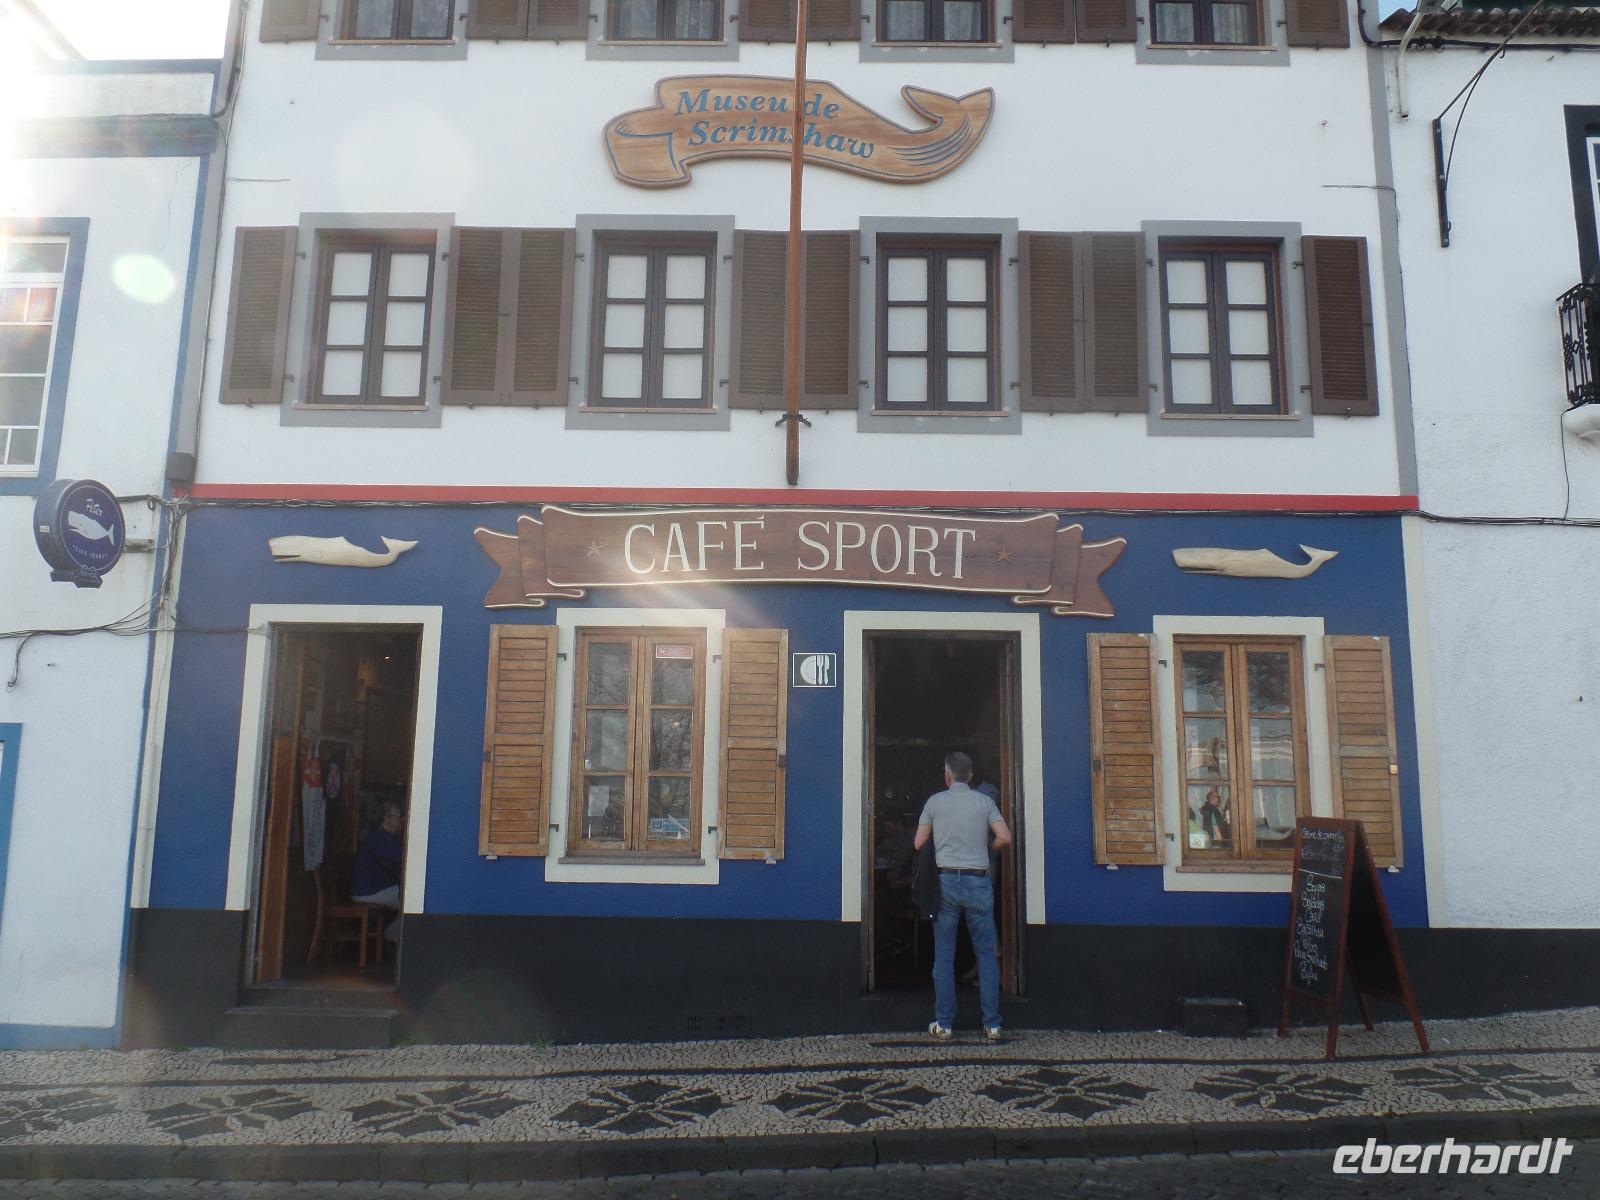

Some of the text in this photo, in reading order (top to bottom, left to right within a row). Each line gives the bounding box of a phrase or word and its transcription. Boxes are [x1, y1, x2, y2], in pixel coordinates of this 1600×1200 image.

[674, 88, 841, 119] Museu de
[688, 118, 875, 159] Scrimhaw
[624, 514, 976, 579] CAFÉ SPORT
